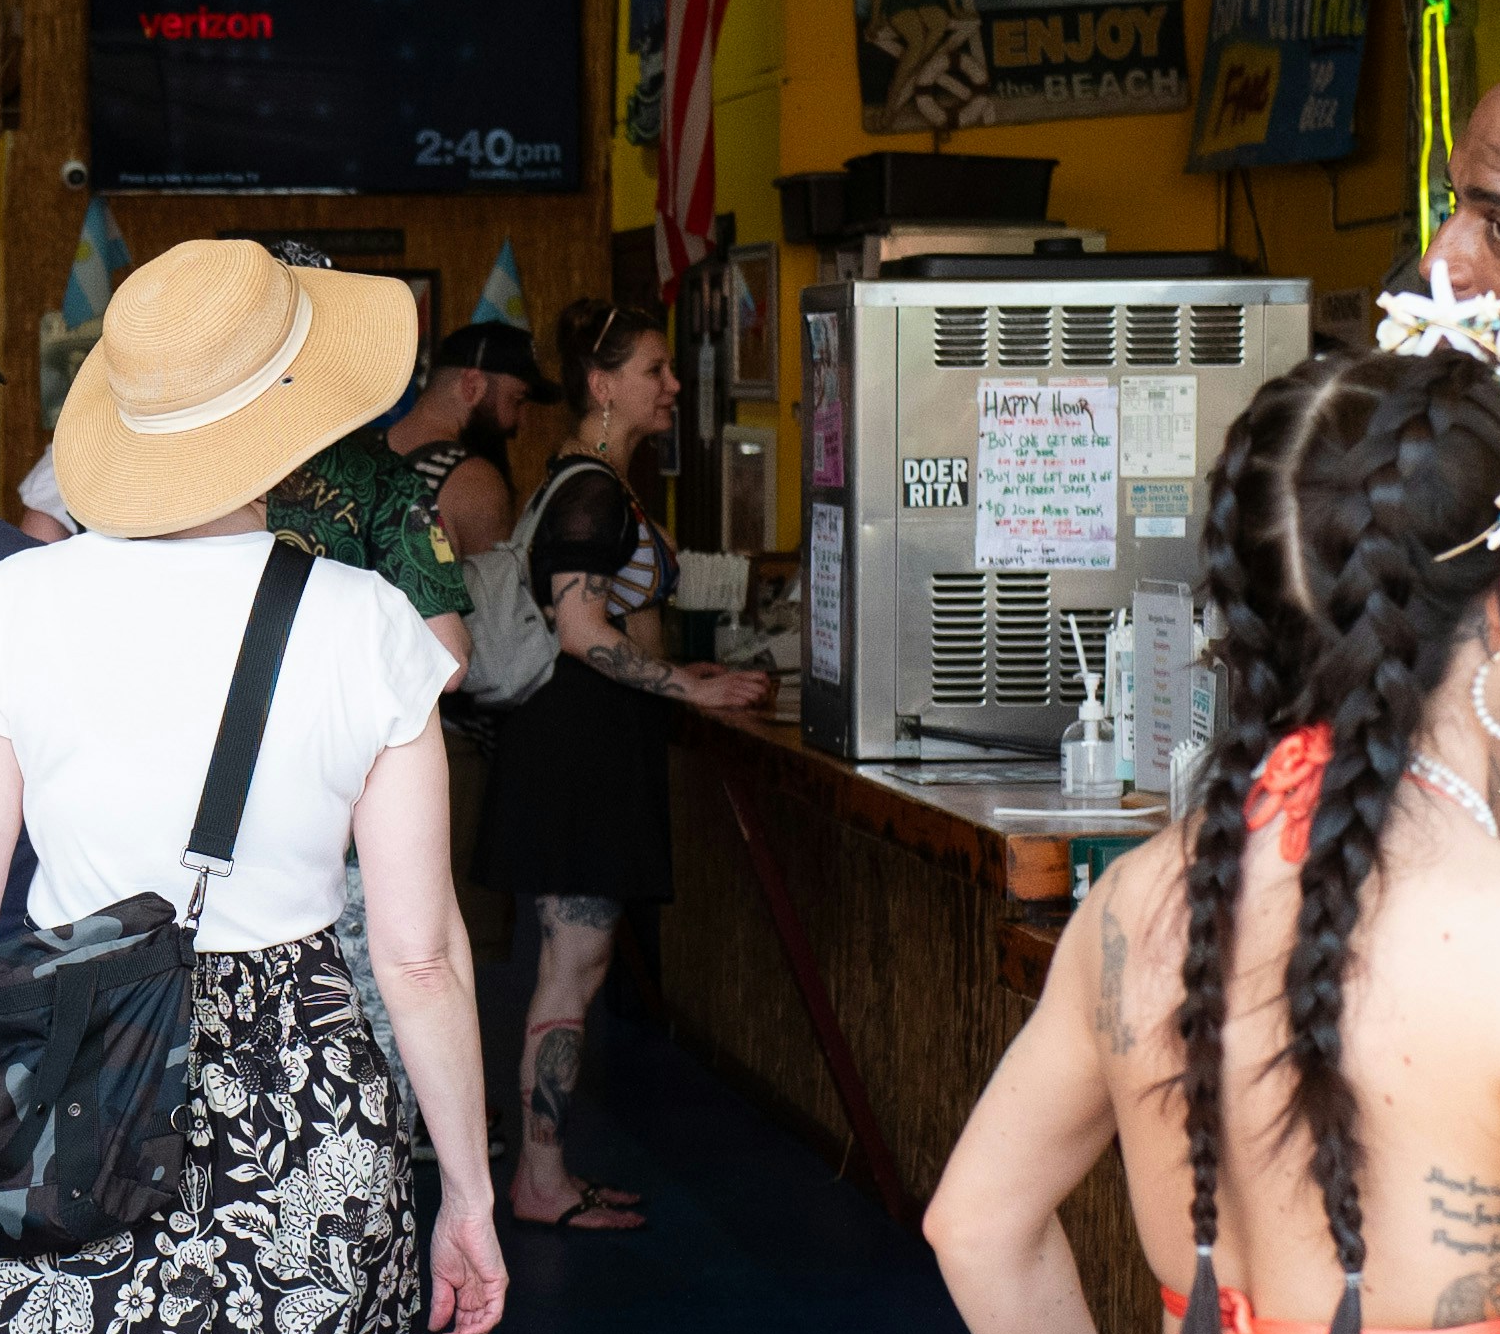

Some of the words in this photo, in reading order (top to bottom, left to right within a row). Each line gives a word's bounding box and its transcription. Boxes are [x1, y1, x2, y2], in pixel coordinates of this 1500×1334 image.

[139, 5, 275, 40] verizon
[992, 5, 1169, 67] ENJOY
[997, 78, 1036, 100] the
[1044, 68, 1181, 102] BEACH
[415, 127, 563, 167] 2:40pm
[984, 391, 1042, 418] HAPPY
[1052, 390, 1096, 429] HOUR
[988, 434, 1013, 449] BUY
[1019, 435, 1039, 449] ONE
[1046, 435, 1068, 449] GET
[903, 458, 968, 483] DOER
[984, 470, 1010, 483] BUY
[906, 482, 964, 508] RITA
